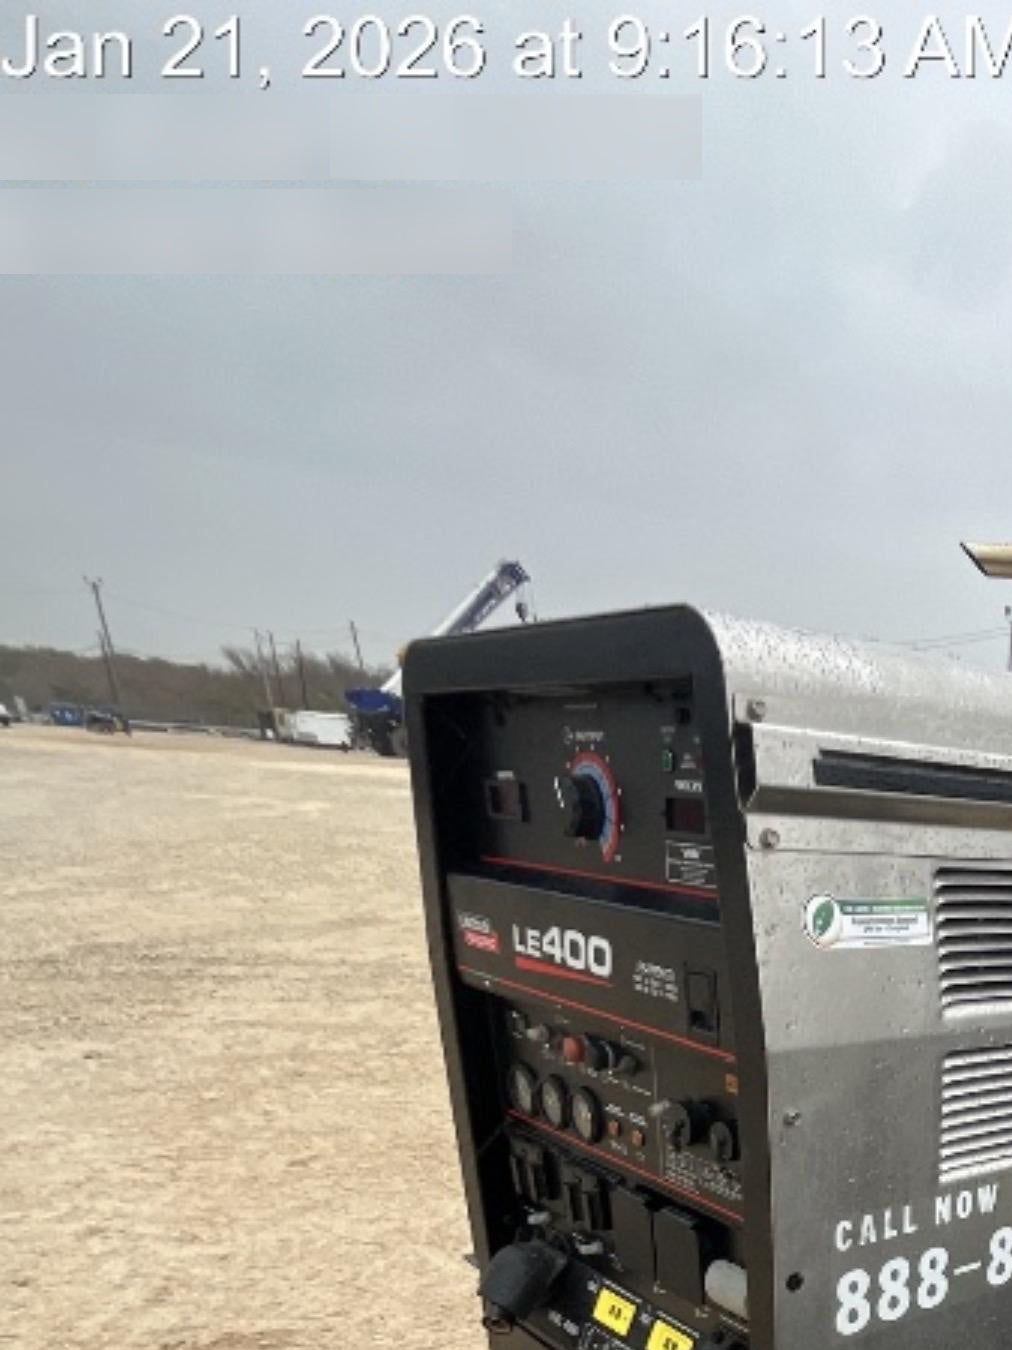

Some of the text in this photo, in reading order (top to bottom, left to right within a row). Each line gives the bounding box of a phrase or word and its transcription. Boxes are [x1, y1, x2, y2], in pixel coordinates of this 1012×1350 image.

[512, 923, 613, 978] LE400
[835, 1184, 999, 1252] CALL NOW
